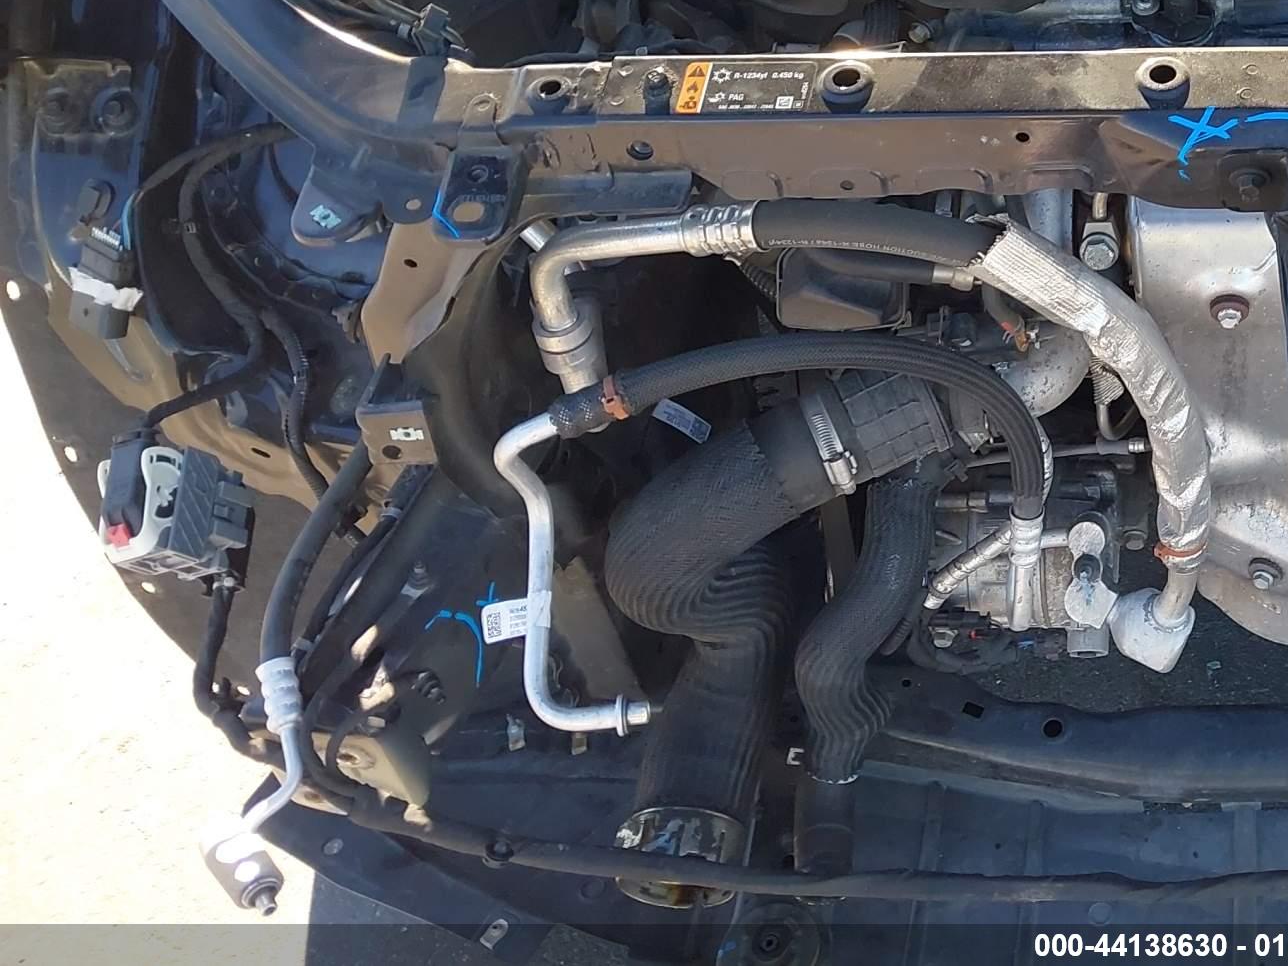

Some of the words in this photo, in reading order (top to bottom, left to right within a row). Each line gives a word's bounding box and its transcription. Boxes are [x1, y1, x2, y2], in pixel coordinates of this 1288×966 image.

[733, 71, 768, 80] R-1234yf
[771, 71, 793, 79] 0.450
[793, 71, 804, 80] kg
[728, 93, 745, 101] PAG
